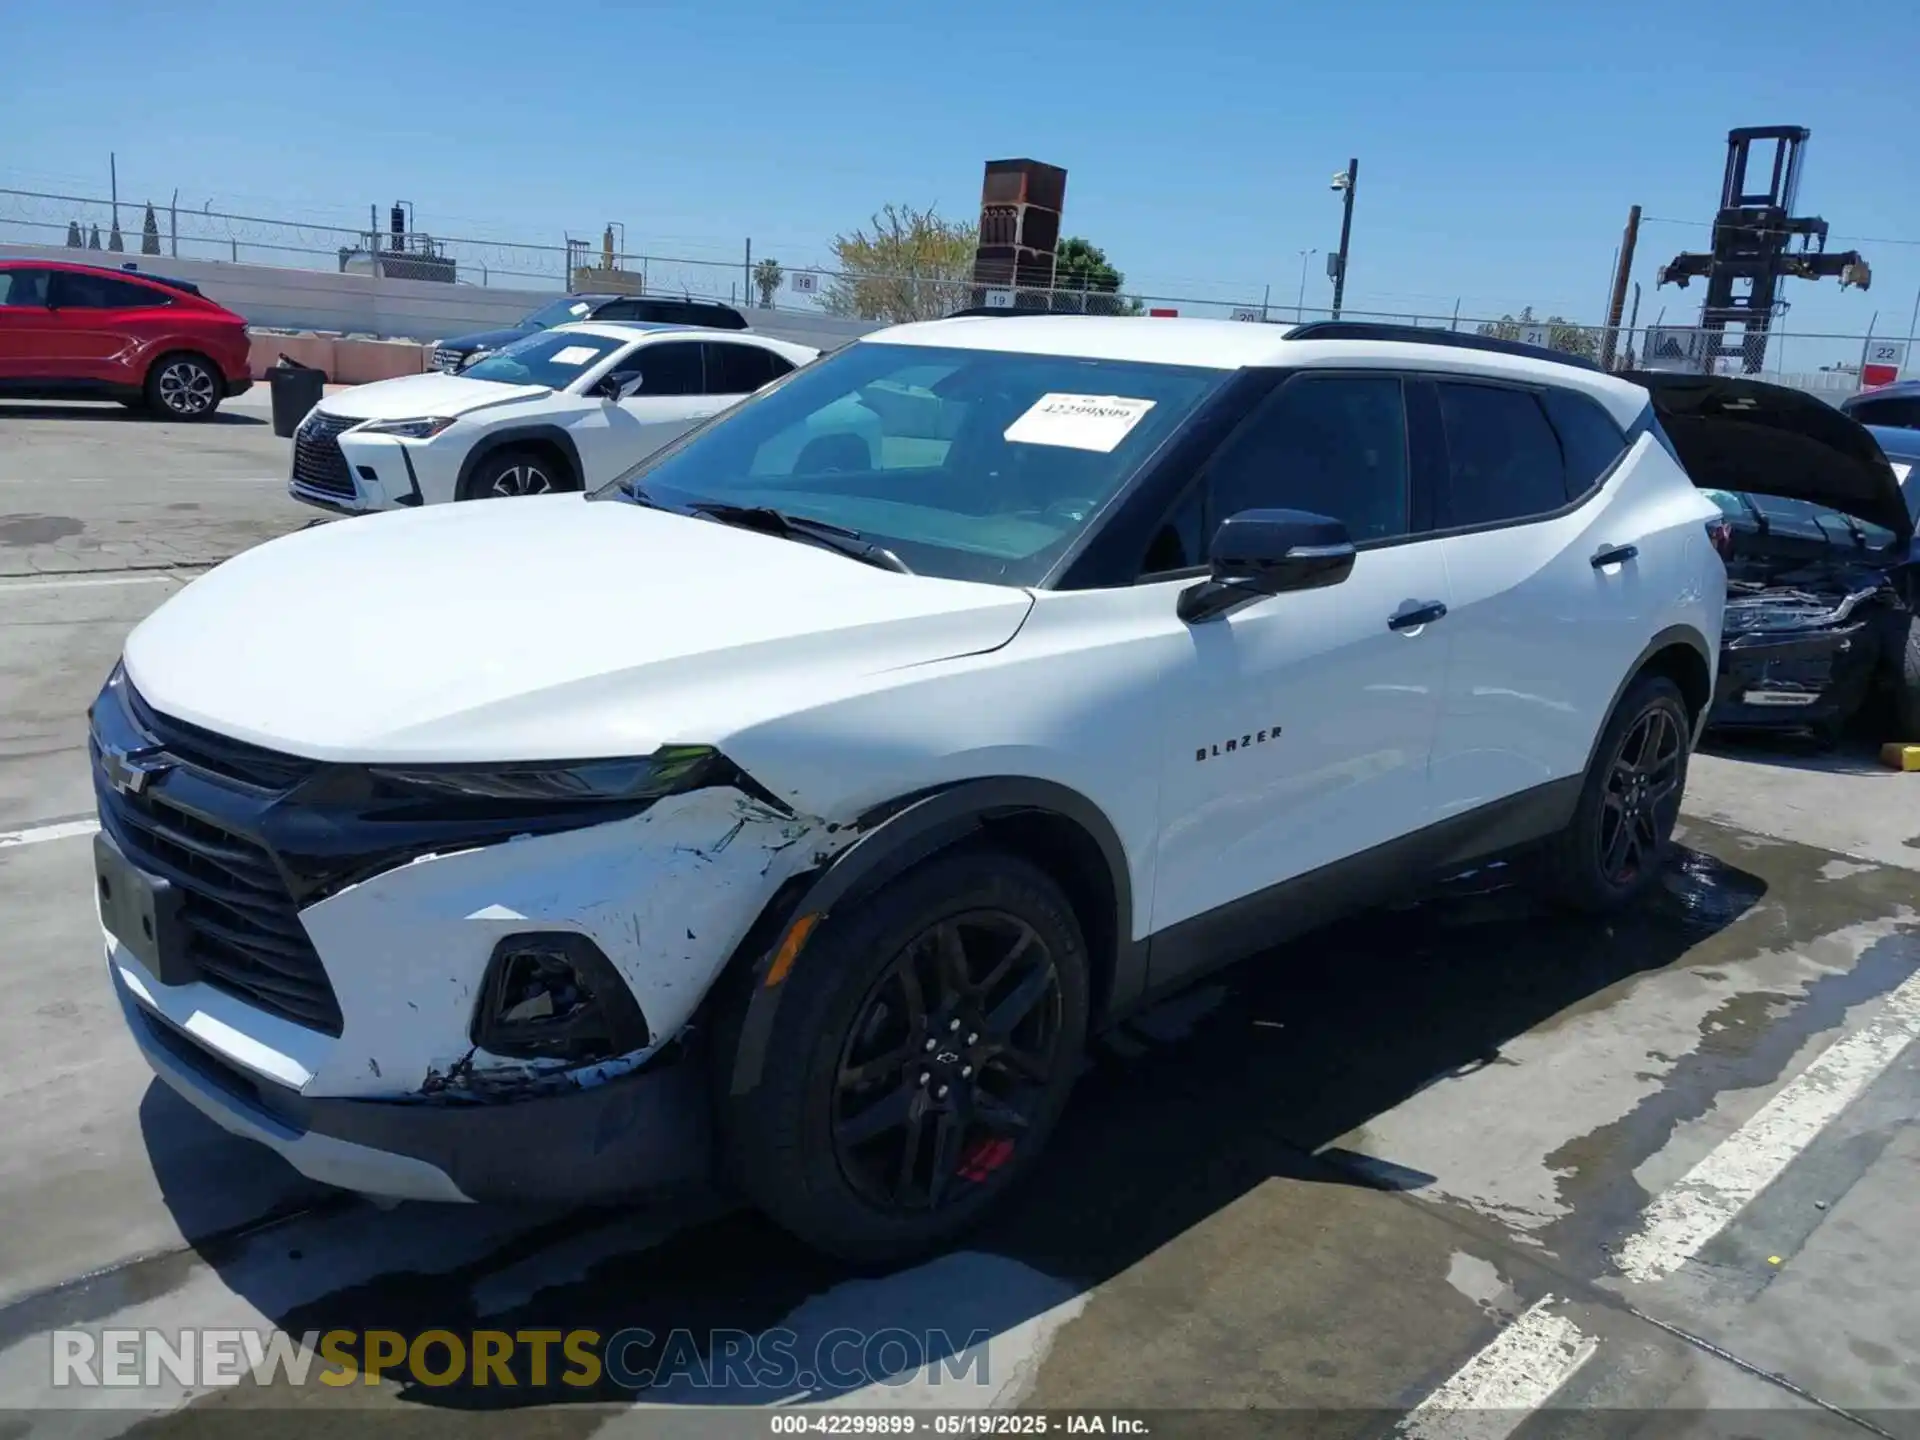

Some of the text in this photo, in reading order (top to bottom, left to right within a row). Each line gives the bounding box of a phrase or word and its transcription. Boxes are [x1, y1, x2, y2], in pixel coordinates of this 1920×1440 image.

[992, 295, 1006, 306] 19
[1527, 332, 1542, 344] 21
[1876, 347, 1895, 359] 22
[1196, 726, 1282, 761] BLAZER
